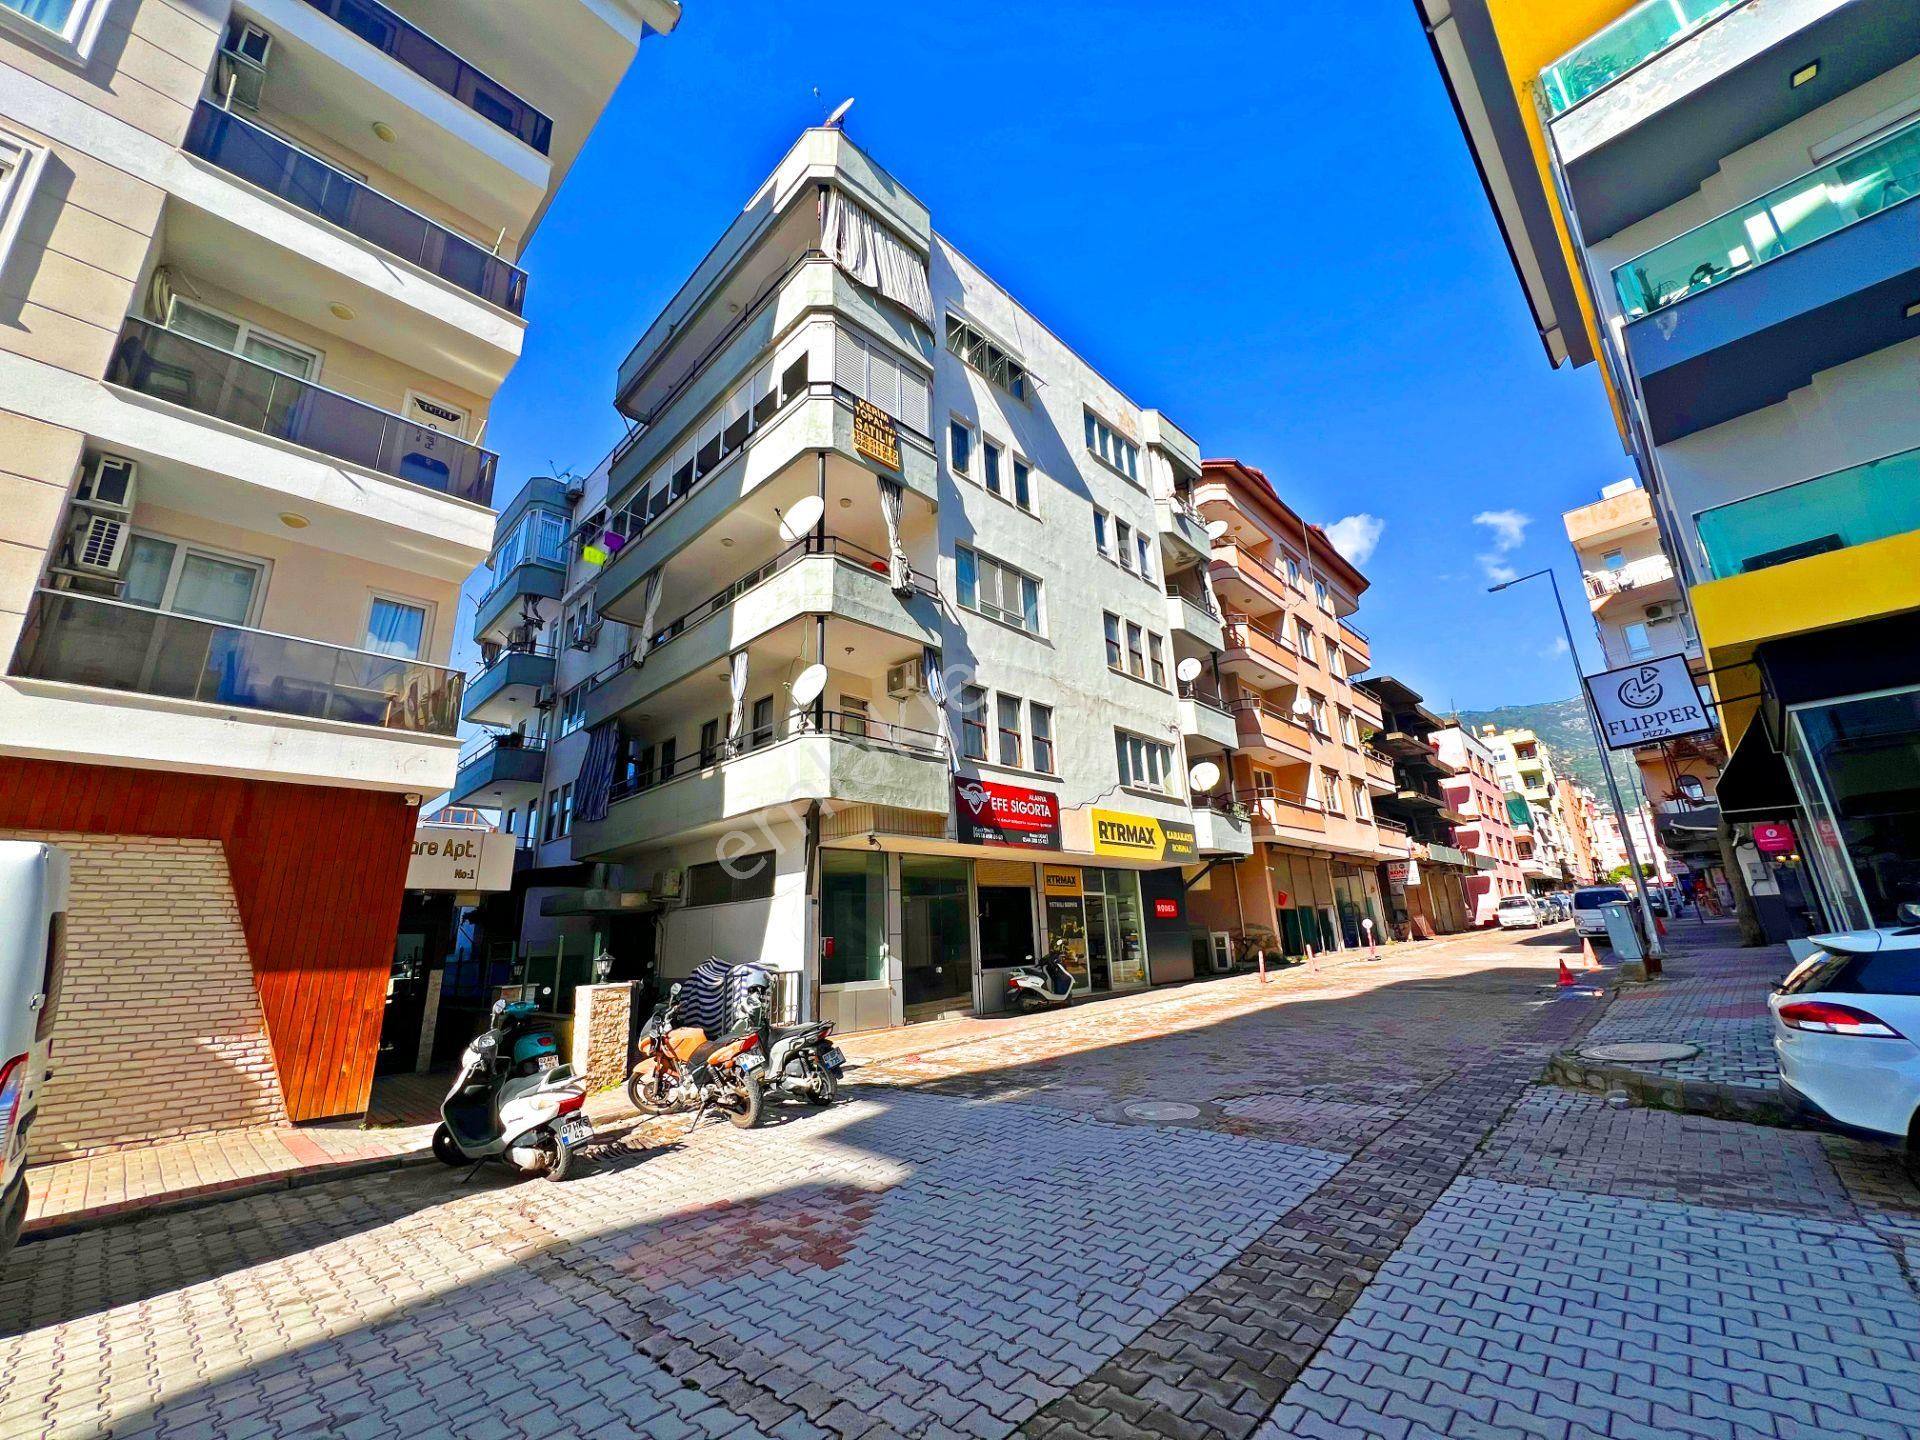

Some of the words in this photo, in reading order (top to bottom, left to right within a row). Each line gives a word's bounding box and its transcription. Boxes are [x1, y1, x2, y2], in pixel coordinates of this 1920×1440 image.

[855, 417, 897, 450] SATILIK
[1608, 705, 1701, 736] FLIPPER
[991, 797, 1008, 812] EFE
[1010, 797, 1052, 817] SİGORTA
[1098, 820, 1156, 845] RTRMAX
[442, 838, 477, 861] Apt.
[454, 868, 475, 879] No:1
[1046, 874, 1075, 885] RTRMAX
[562, 1125, 572, 1135] 07
[574, 1130, 584, 1139] 42
